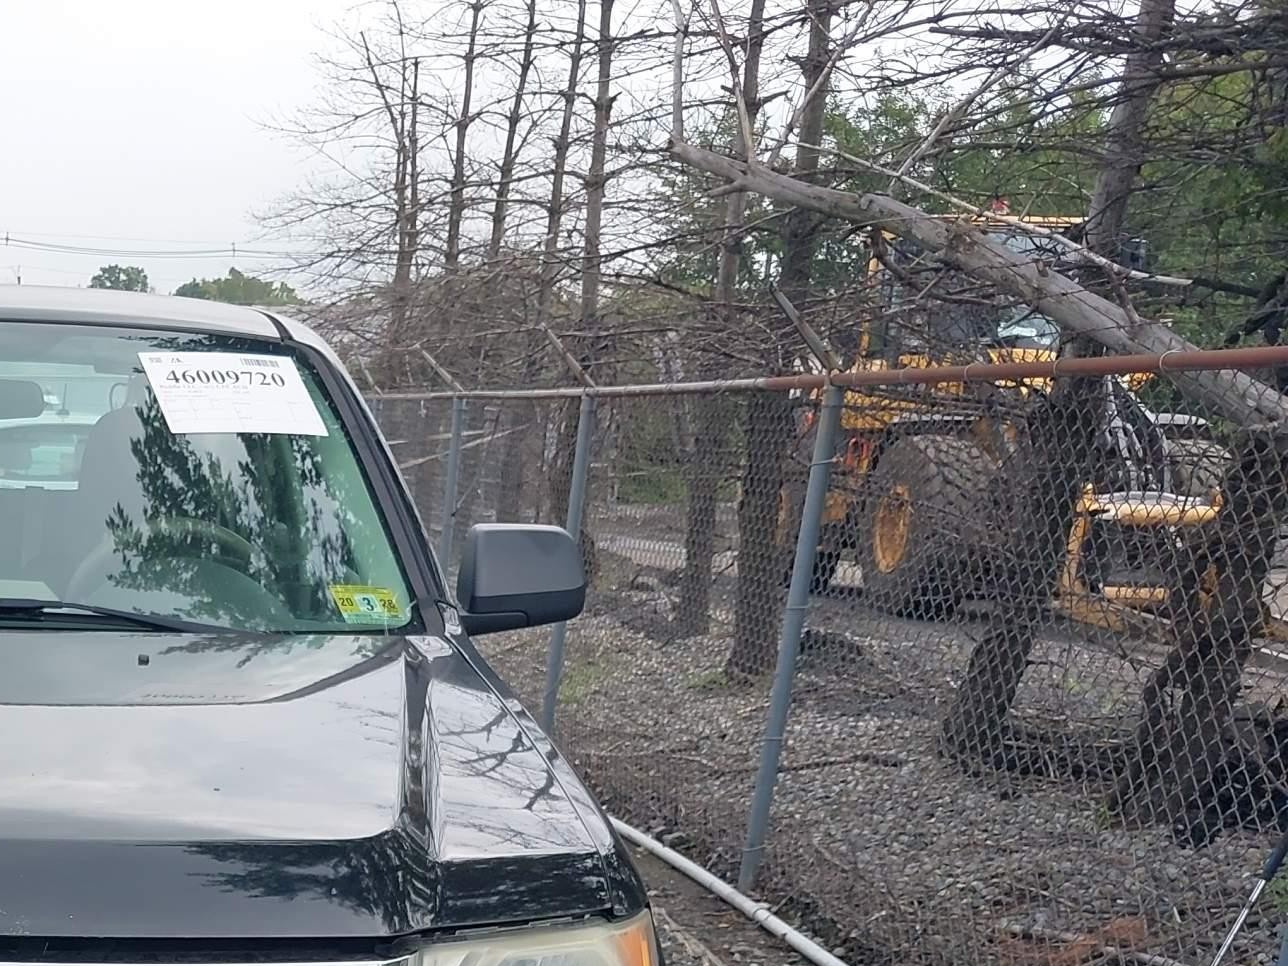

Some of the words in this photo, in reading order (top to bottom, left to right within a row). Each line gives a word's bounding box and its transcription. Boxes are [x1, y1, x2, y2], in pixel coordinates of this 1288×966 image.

[166, 369, 286, 387] 46009720
[338, 597, 354, 607] 20
[362, 597, 375, 611] 3
